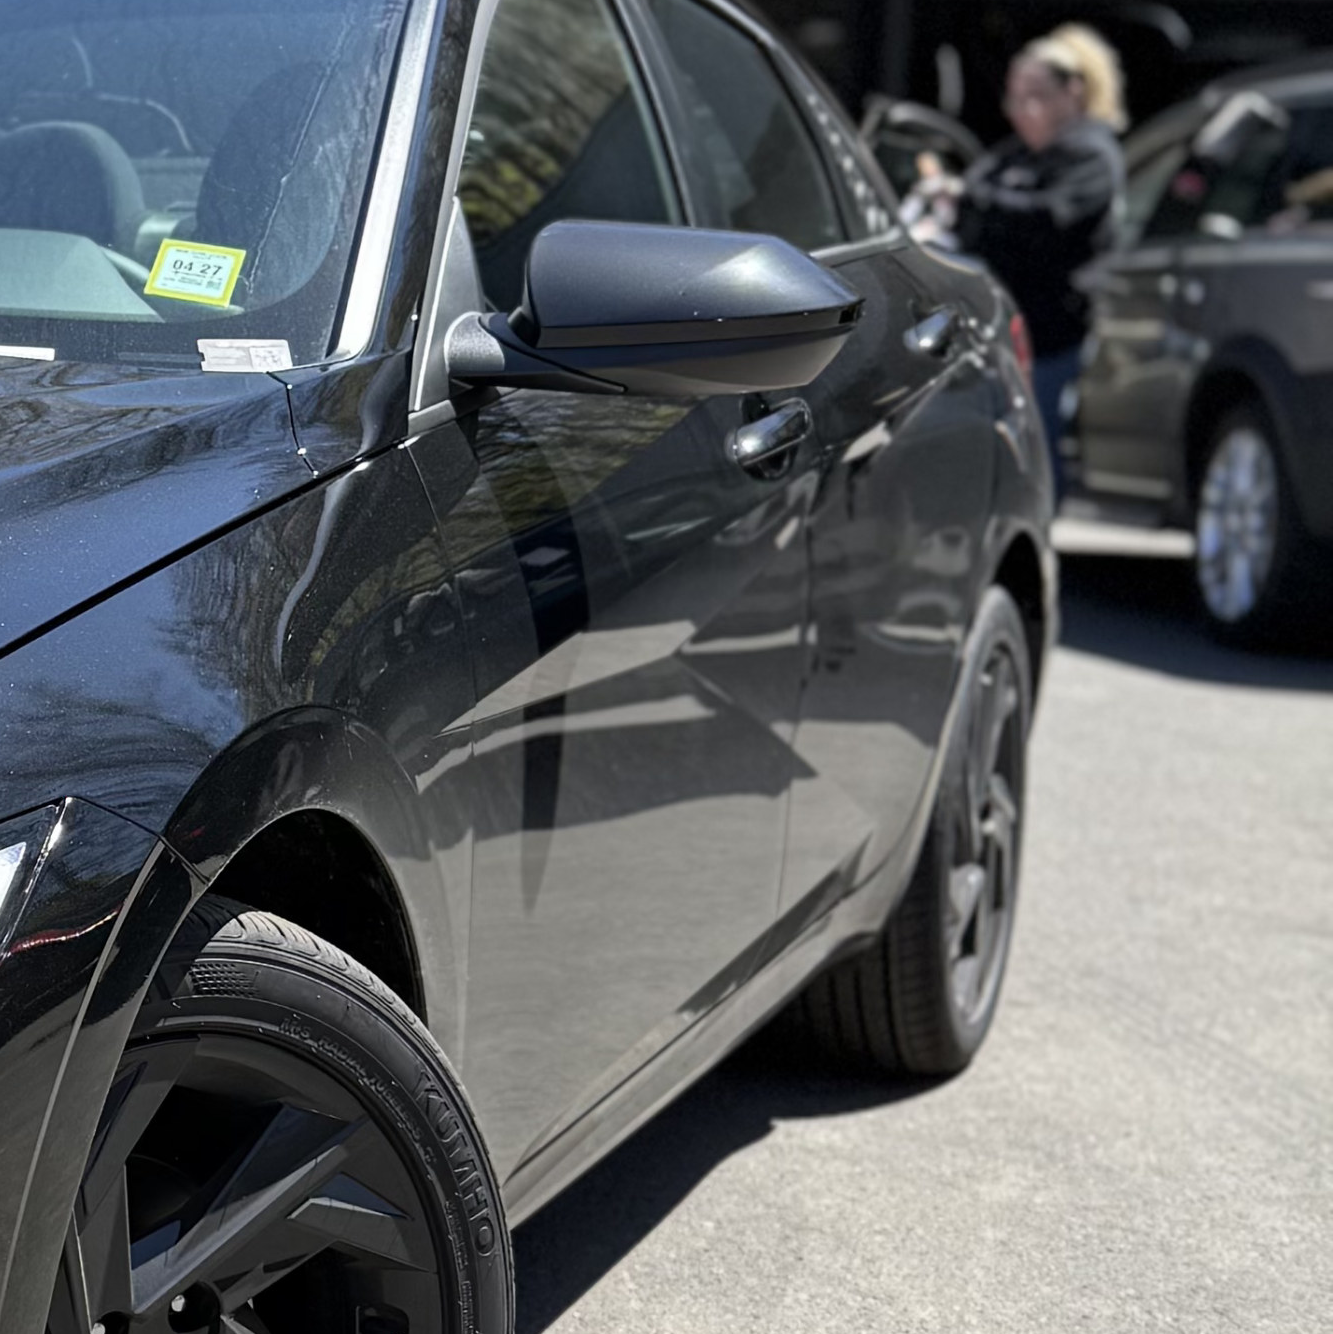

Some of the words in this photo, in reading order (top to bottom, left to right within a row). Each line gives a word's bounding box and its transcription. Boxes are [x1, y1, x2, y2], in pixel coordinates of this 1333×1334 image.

[172, 260, 193, 272] 04
[200, 263, 222, 277] 27
[413, 1068, 496, 1257] KUMHO
